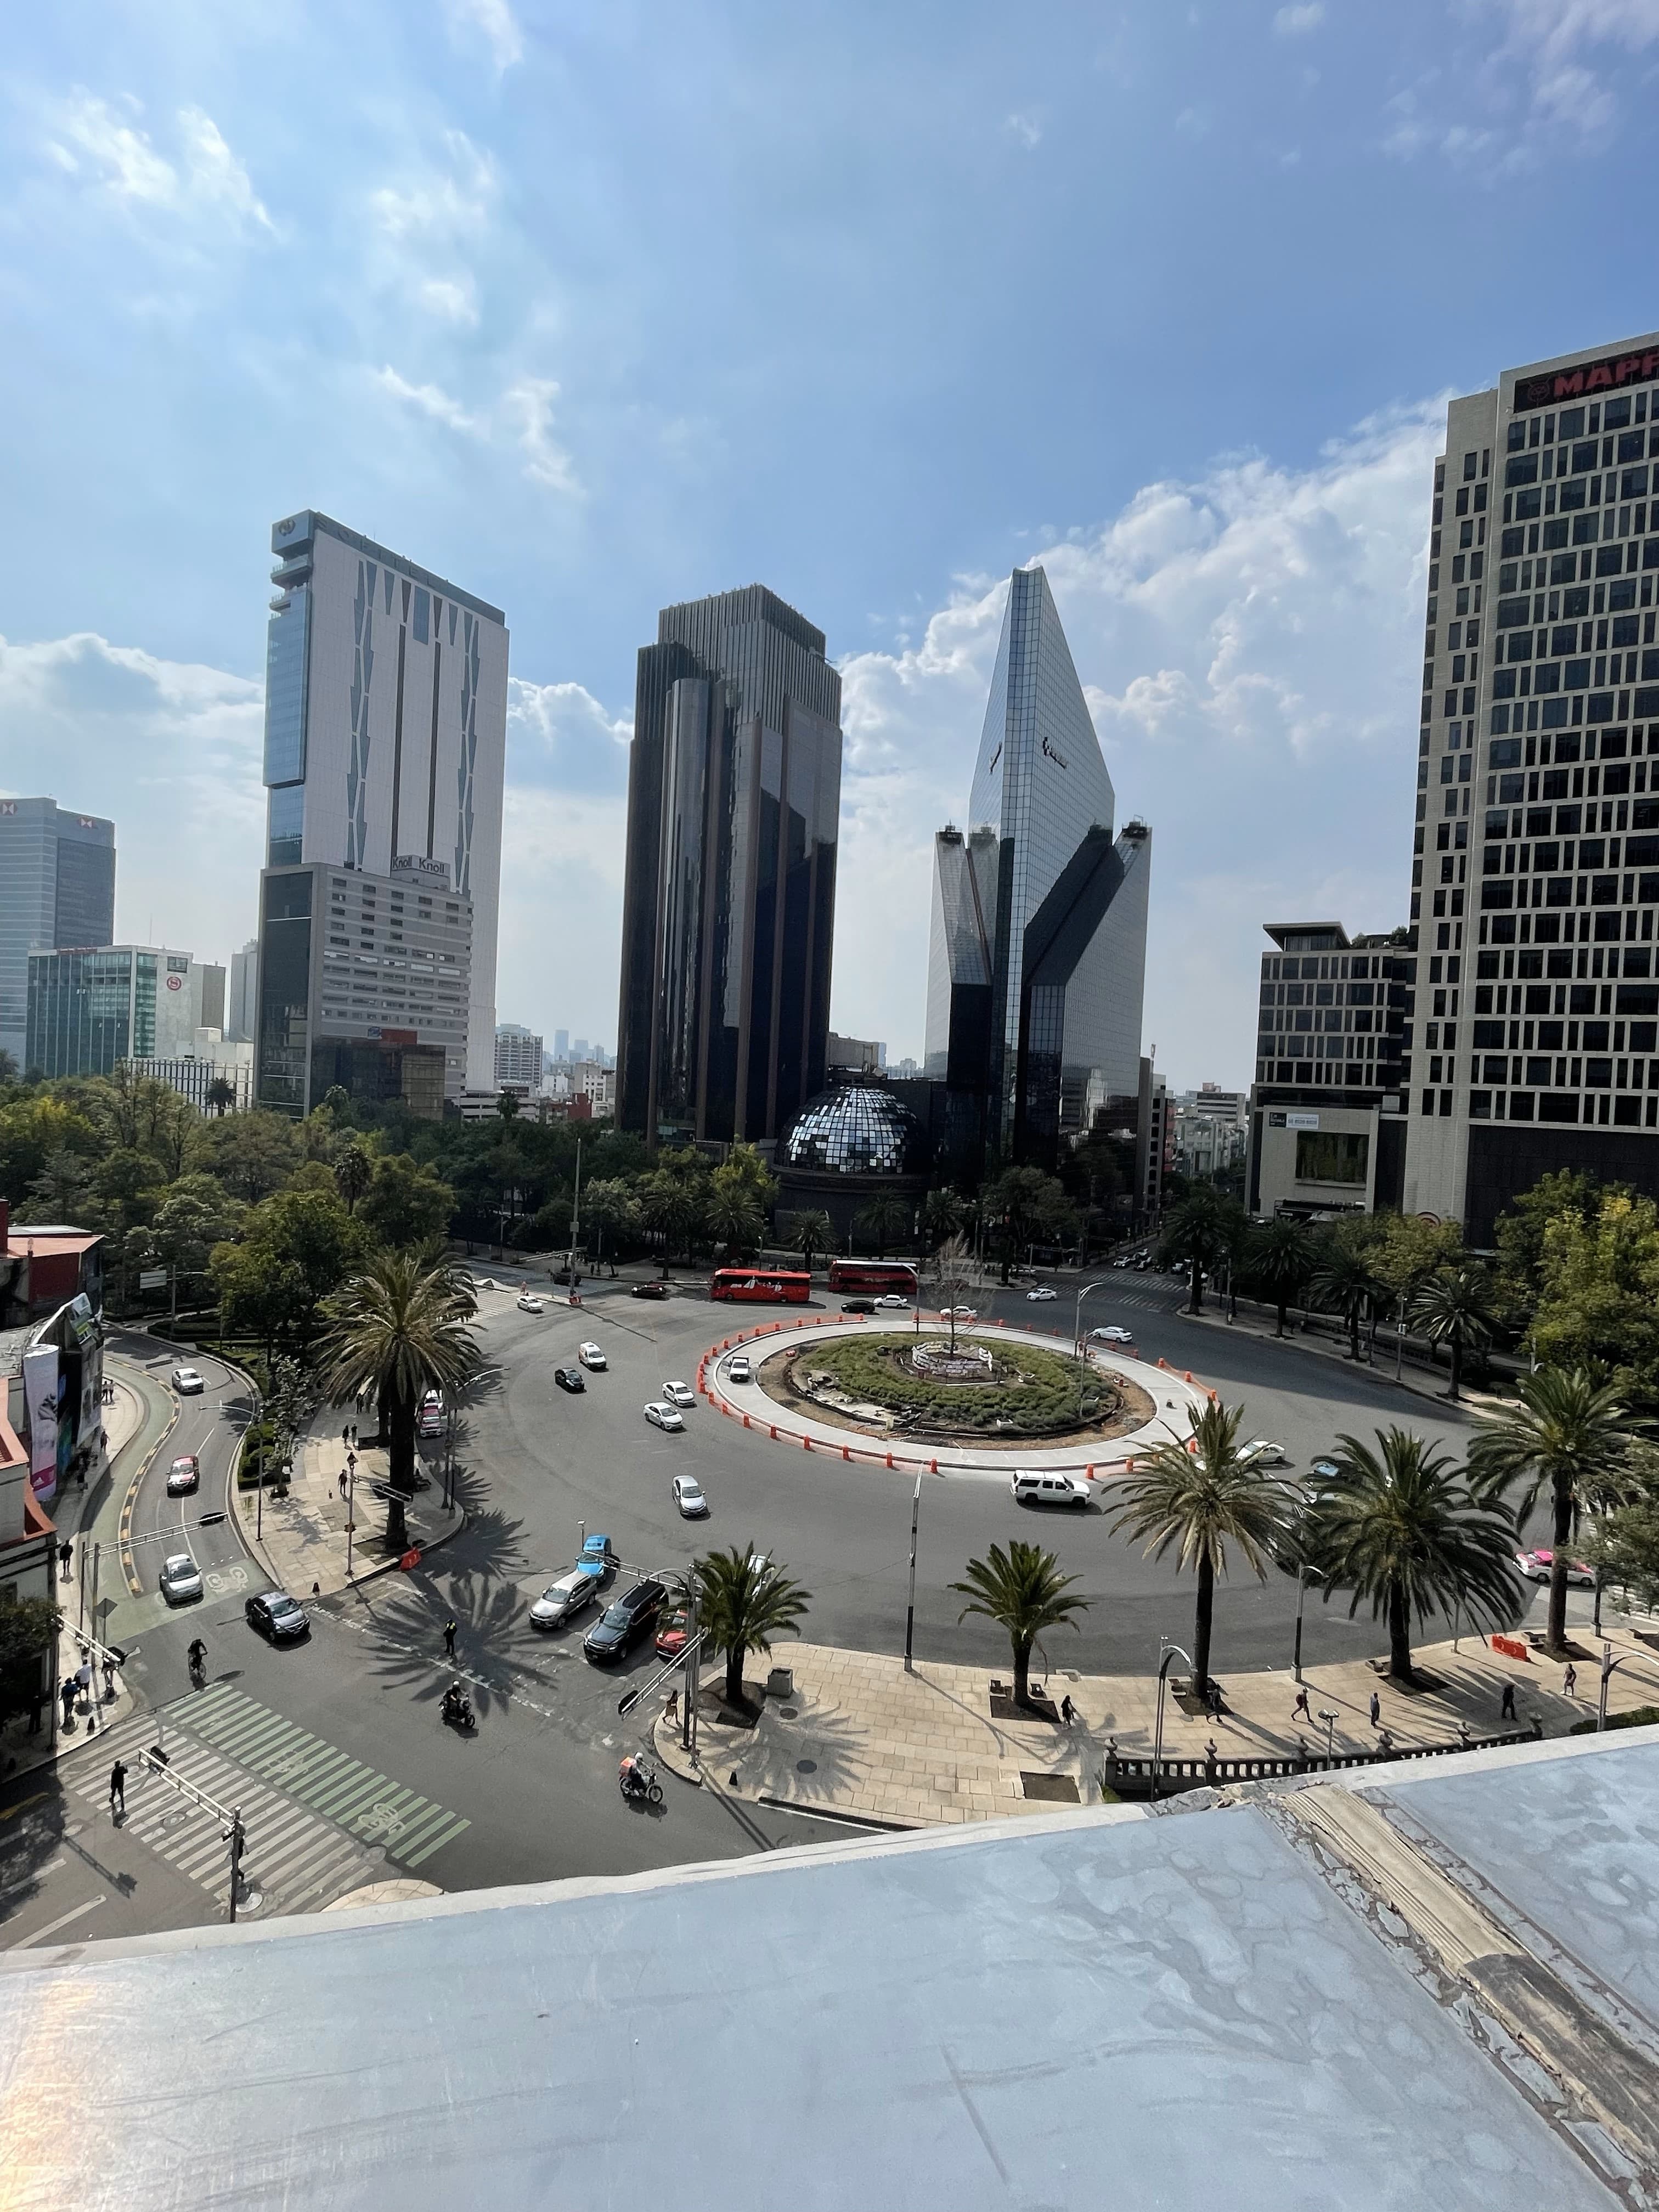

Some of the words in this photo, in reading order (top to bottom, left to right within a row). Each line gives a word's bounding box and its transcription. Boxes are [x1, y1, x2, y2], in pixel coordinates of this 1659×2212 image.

[314, 518, 435, 589] SOFITEL
[392, 856, 413, 868] Knoll
[419, 858, 445, 874] Knoll
